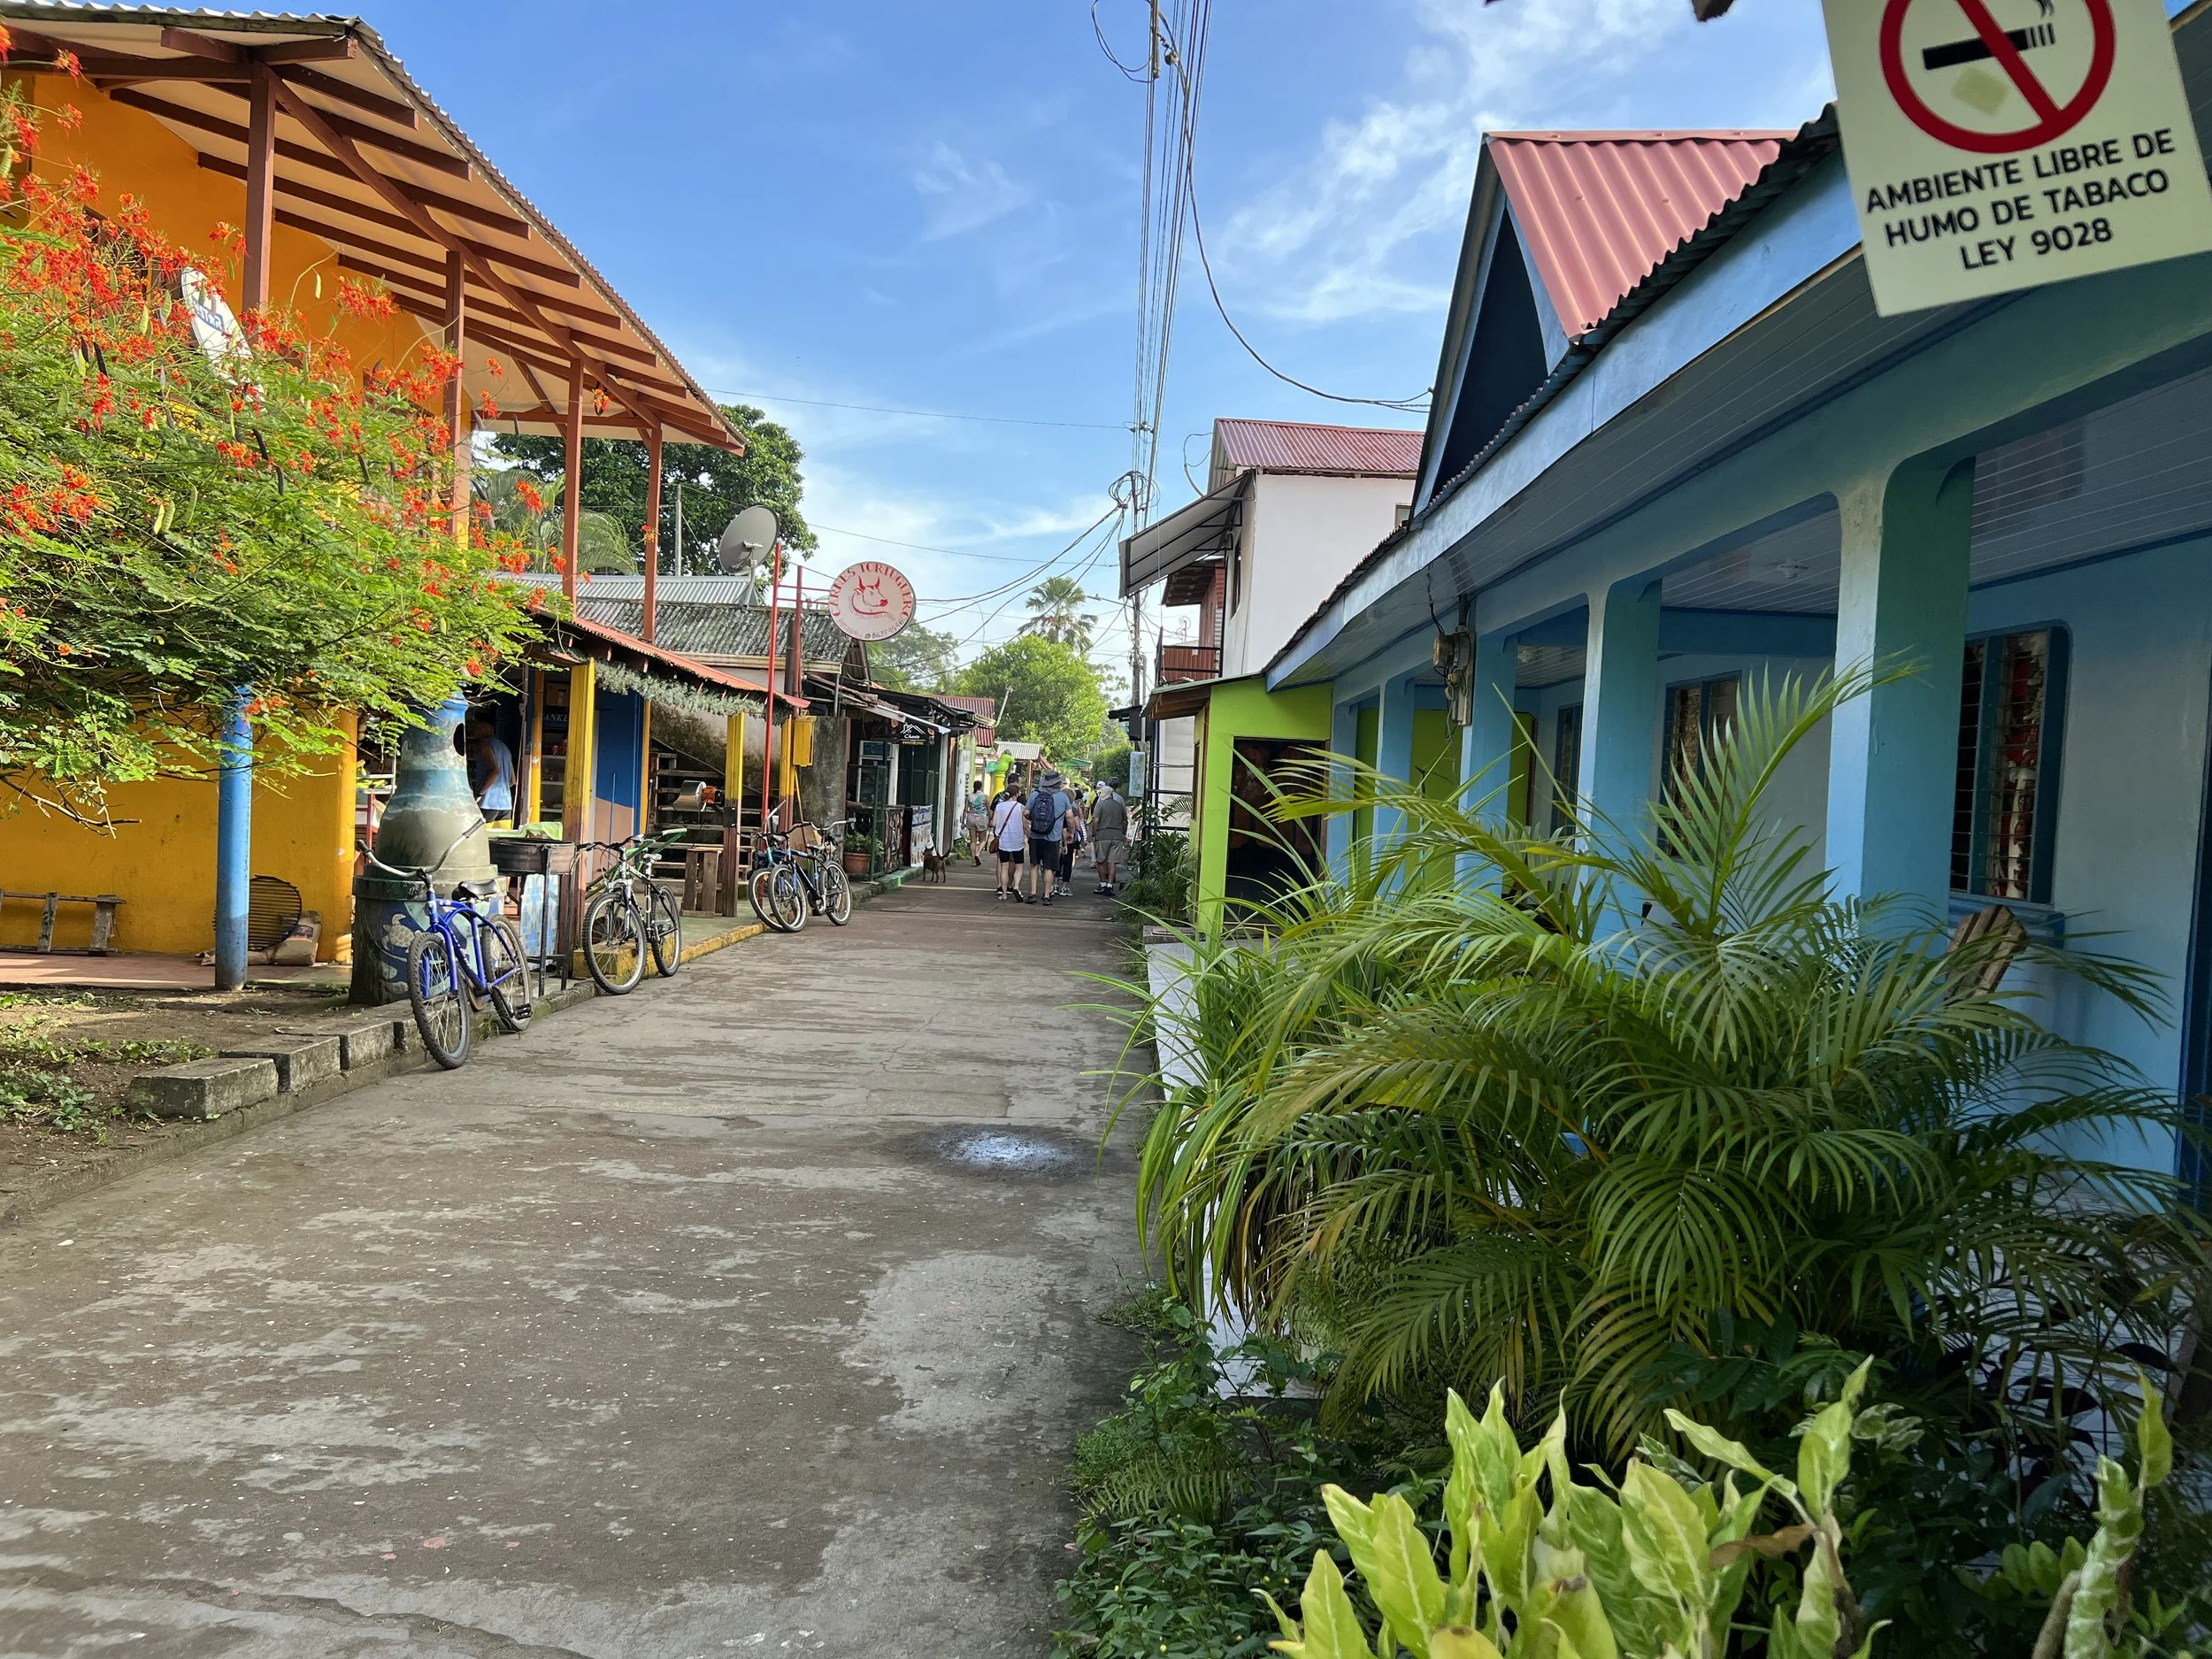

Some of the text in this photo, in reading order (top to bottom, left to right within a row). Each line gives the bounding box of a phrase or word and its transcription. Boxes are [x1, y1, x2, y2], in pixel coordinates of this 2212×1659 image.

[1867, 127, 2175, 213] AMBIENTE LIBRE DE
[1885, 168, 2169, 248] HUMO DE TABACO
[1960, 217, 2113, 270] LEY 9028
[860, 563, 912, 618] TORTUGUERO
